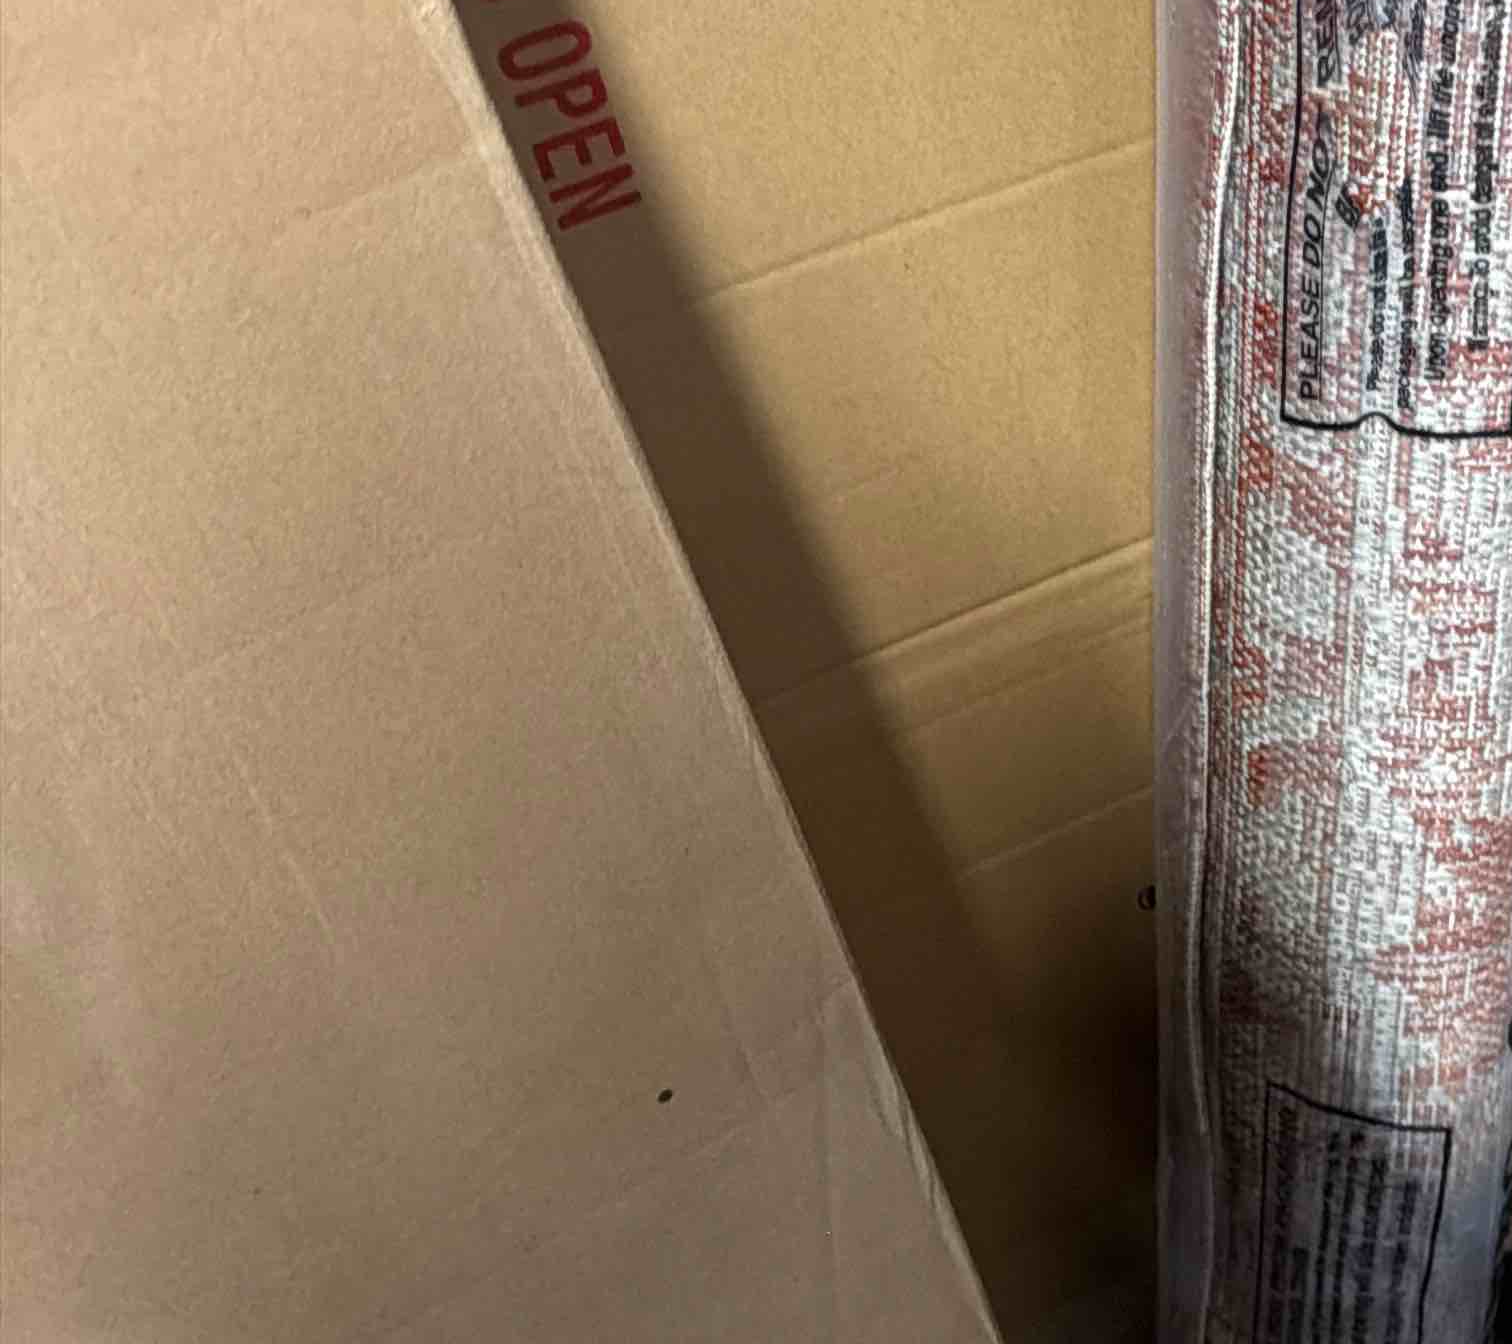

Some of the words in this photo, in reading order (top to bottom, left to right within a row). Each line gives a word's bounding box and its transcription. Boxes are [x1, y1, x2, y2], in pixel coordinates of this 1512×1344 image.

[497, 21, 643, 235] OPEN
[1302, 216, 1325, 268] DO
[1300, 269, 1323, 401] PLEASE
